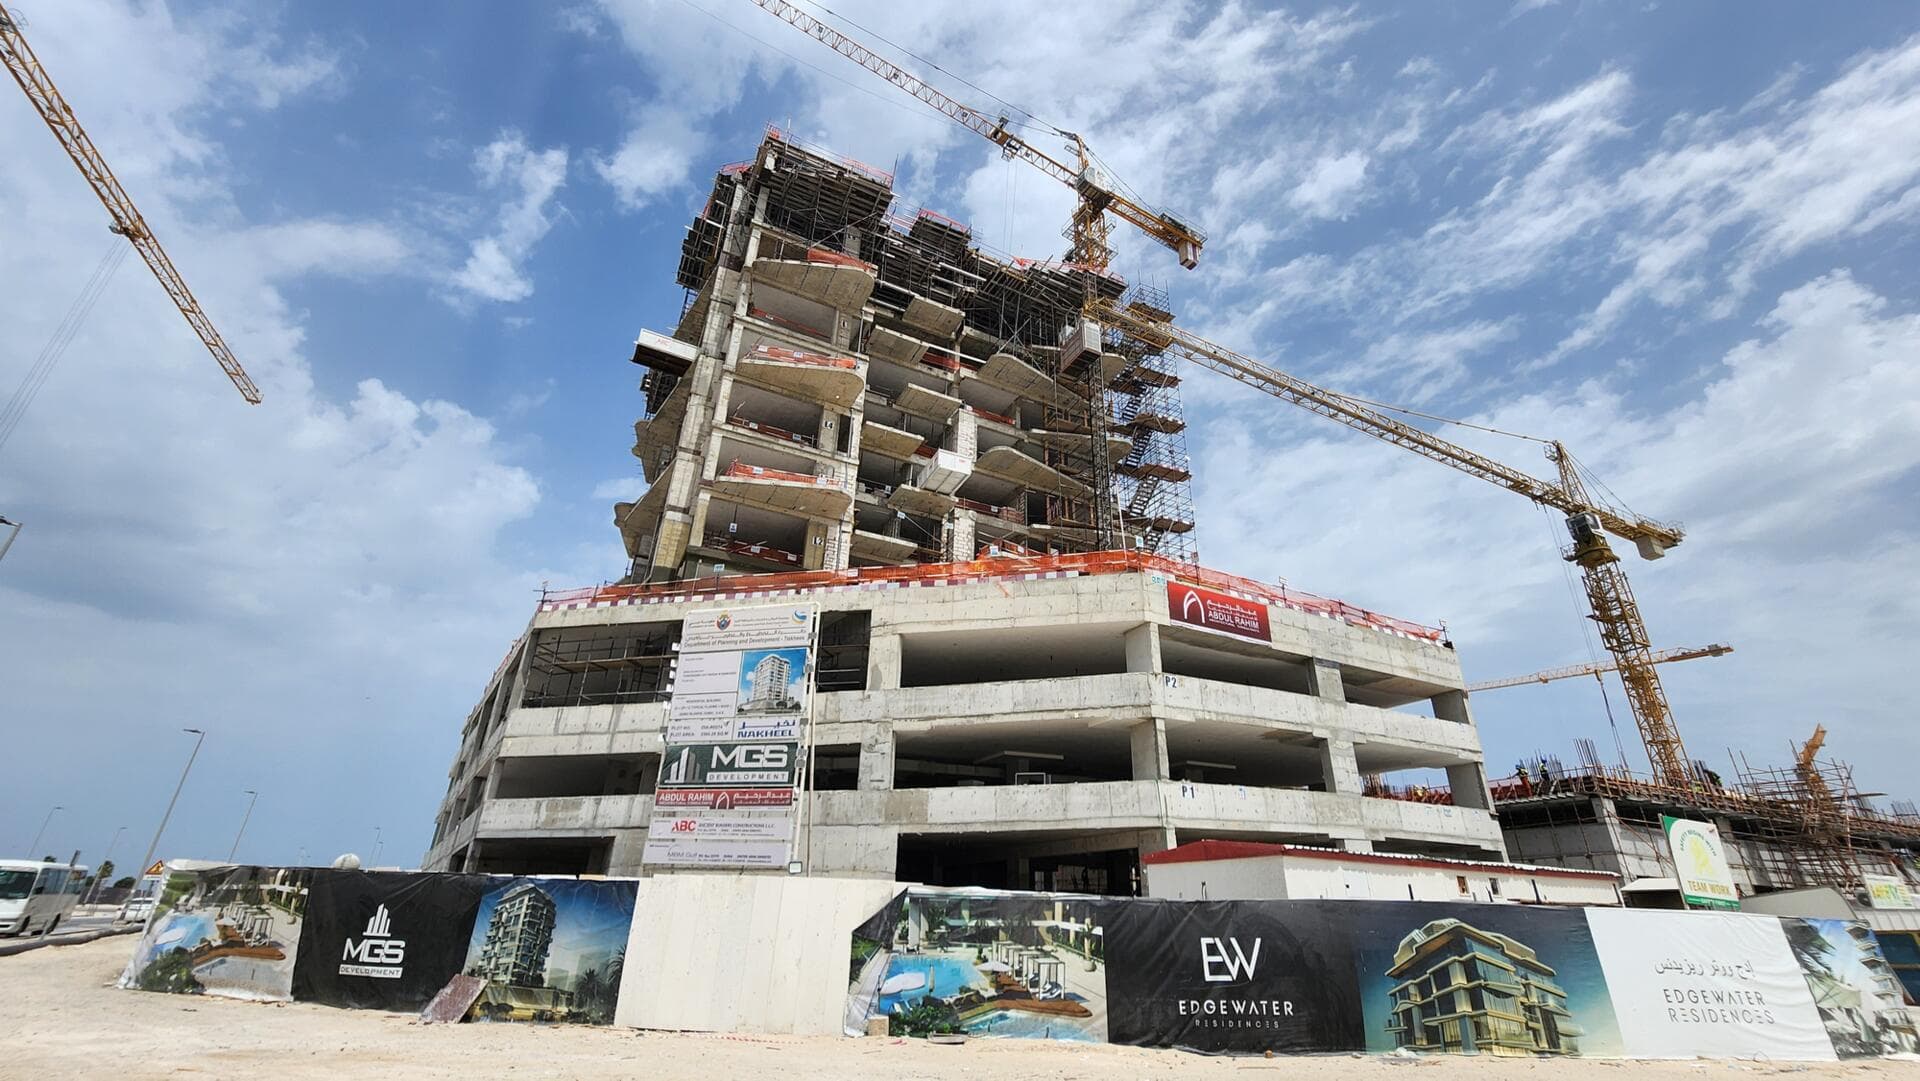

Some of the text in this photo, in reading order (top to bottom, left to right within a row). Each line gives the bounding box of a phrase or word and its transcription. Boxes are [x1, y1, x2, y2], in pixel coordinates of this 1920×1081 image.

[1208, 611, 1233, 624] ABDUL
[1235, 616, 1260, 630] RAHIM
[684, 639, 710, 648] Department
[718, 638, 737, 646] Planning
[1165, 676, 1177, 688] P2
[737, 729, 795, 738] NAKHEEL
[711, 744, 788, 768] MGS
[709, 773, 786, 781] DEVELOPMENT
[659, 791, 714, 802] ABDUL RAHIM
[1182, 785, 1195, 798] P1
[672, 820, 697, 832] ABC
[1687, 880, 1732, 896] TEAM WORK
[342, 937, 406, 964] MGS
[1200, 937, 1262, 982] EW
[340, 966, 401, 976] DEVELOPMENT
[1663, 988, 1766, 1005] EDGEWATER
[1178, 999, 1294, 1016] EDGEWATER
[1668, 1007, 1776, 1024] RESIDENCES
[1195, 1018, 1280, 1029] RESIDENCES
